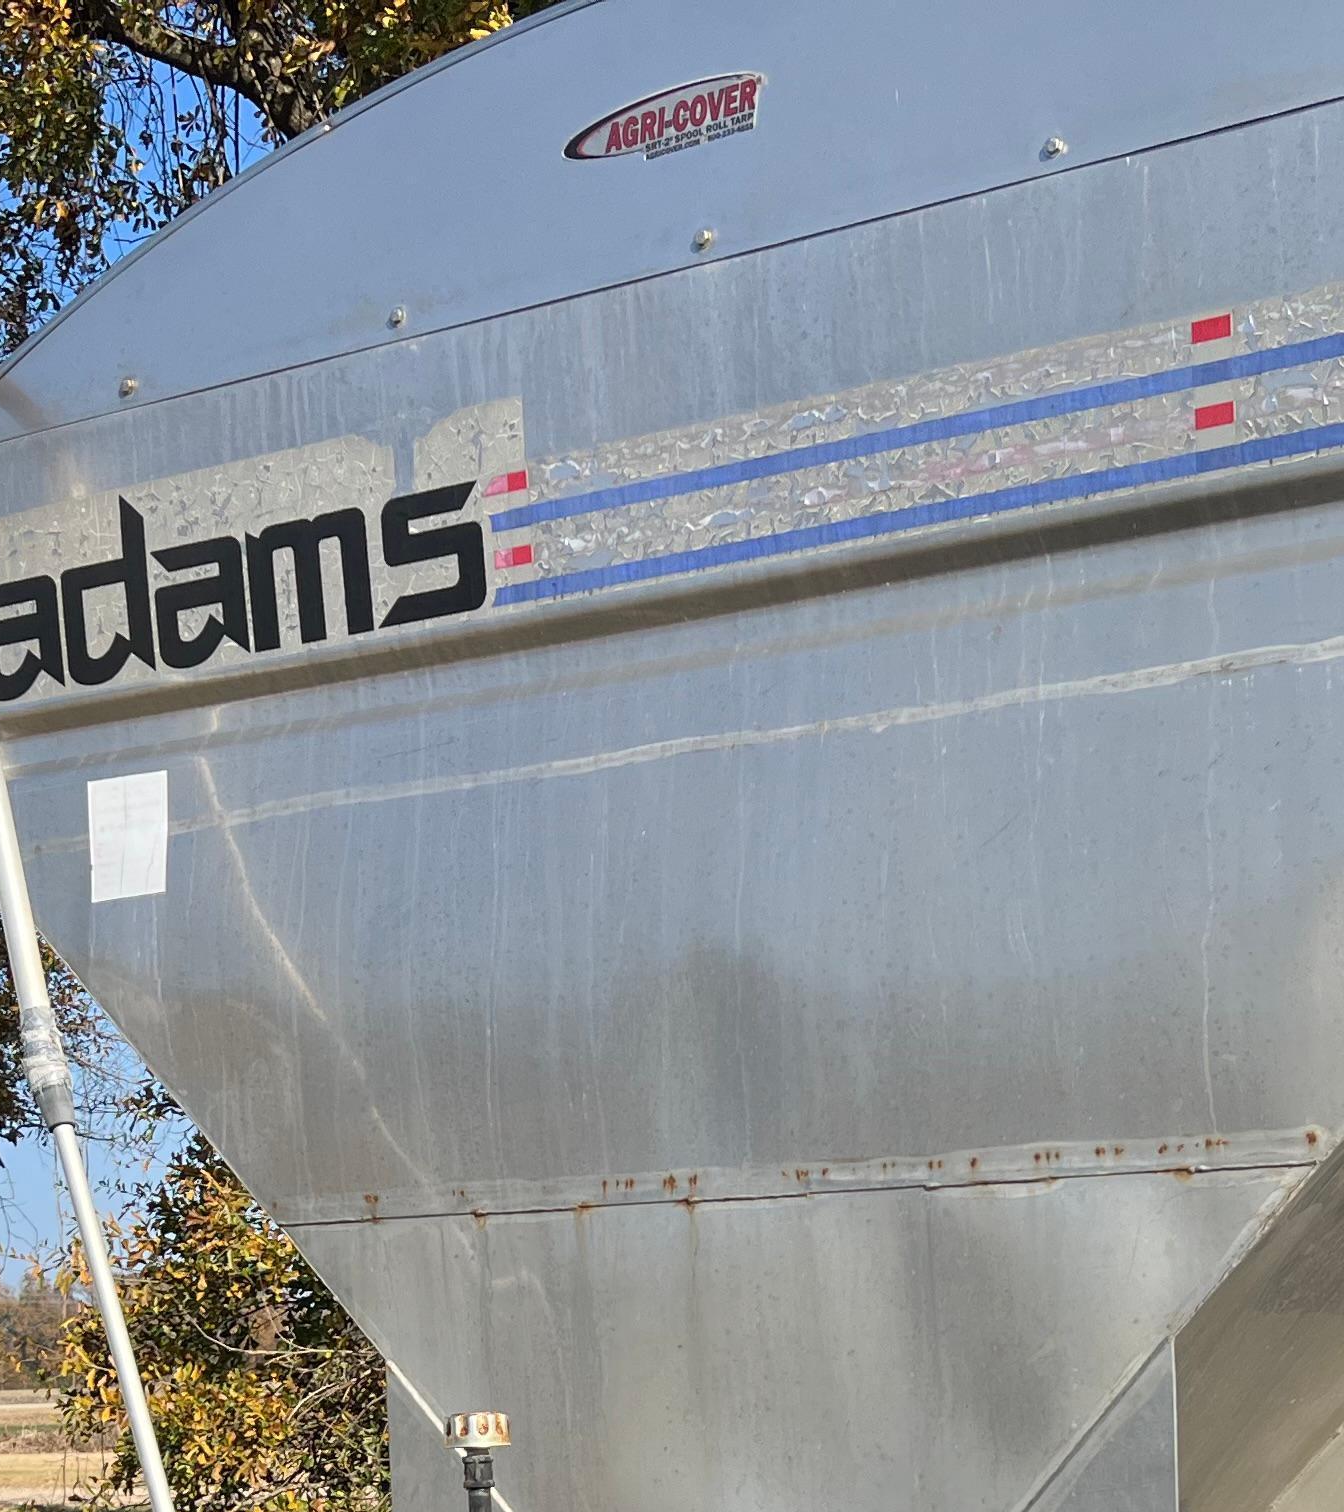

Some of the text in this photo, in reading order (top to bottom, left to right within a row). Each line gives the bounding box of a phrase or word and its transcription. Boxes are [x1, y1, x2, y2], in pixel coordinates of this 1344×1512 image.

[605, 78, 757, 154] AGRI-COVER
[674, 128, 704, 143] SPOOL
[706, 120, 728, 134] ROLL
[730, 112, 754, 127] TARP
